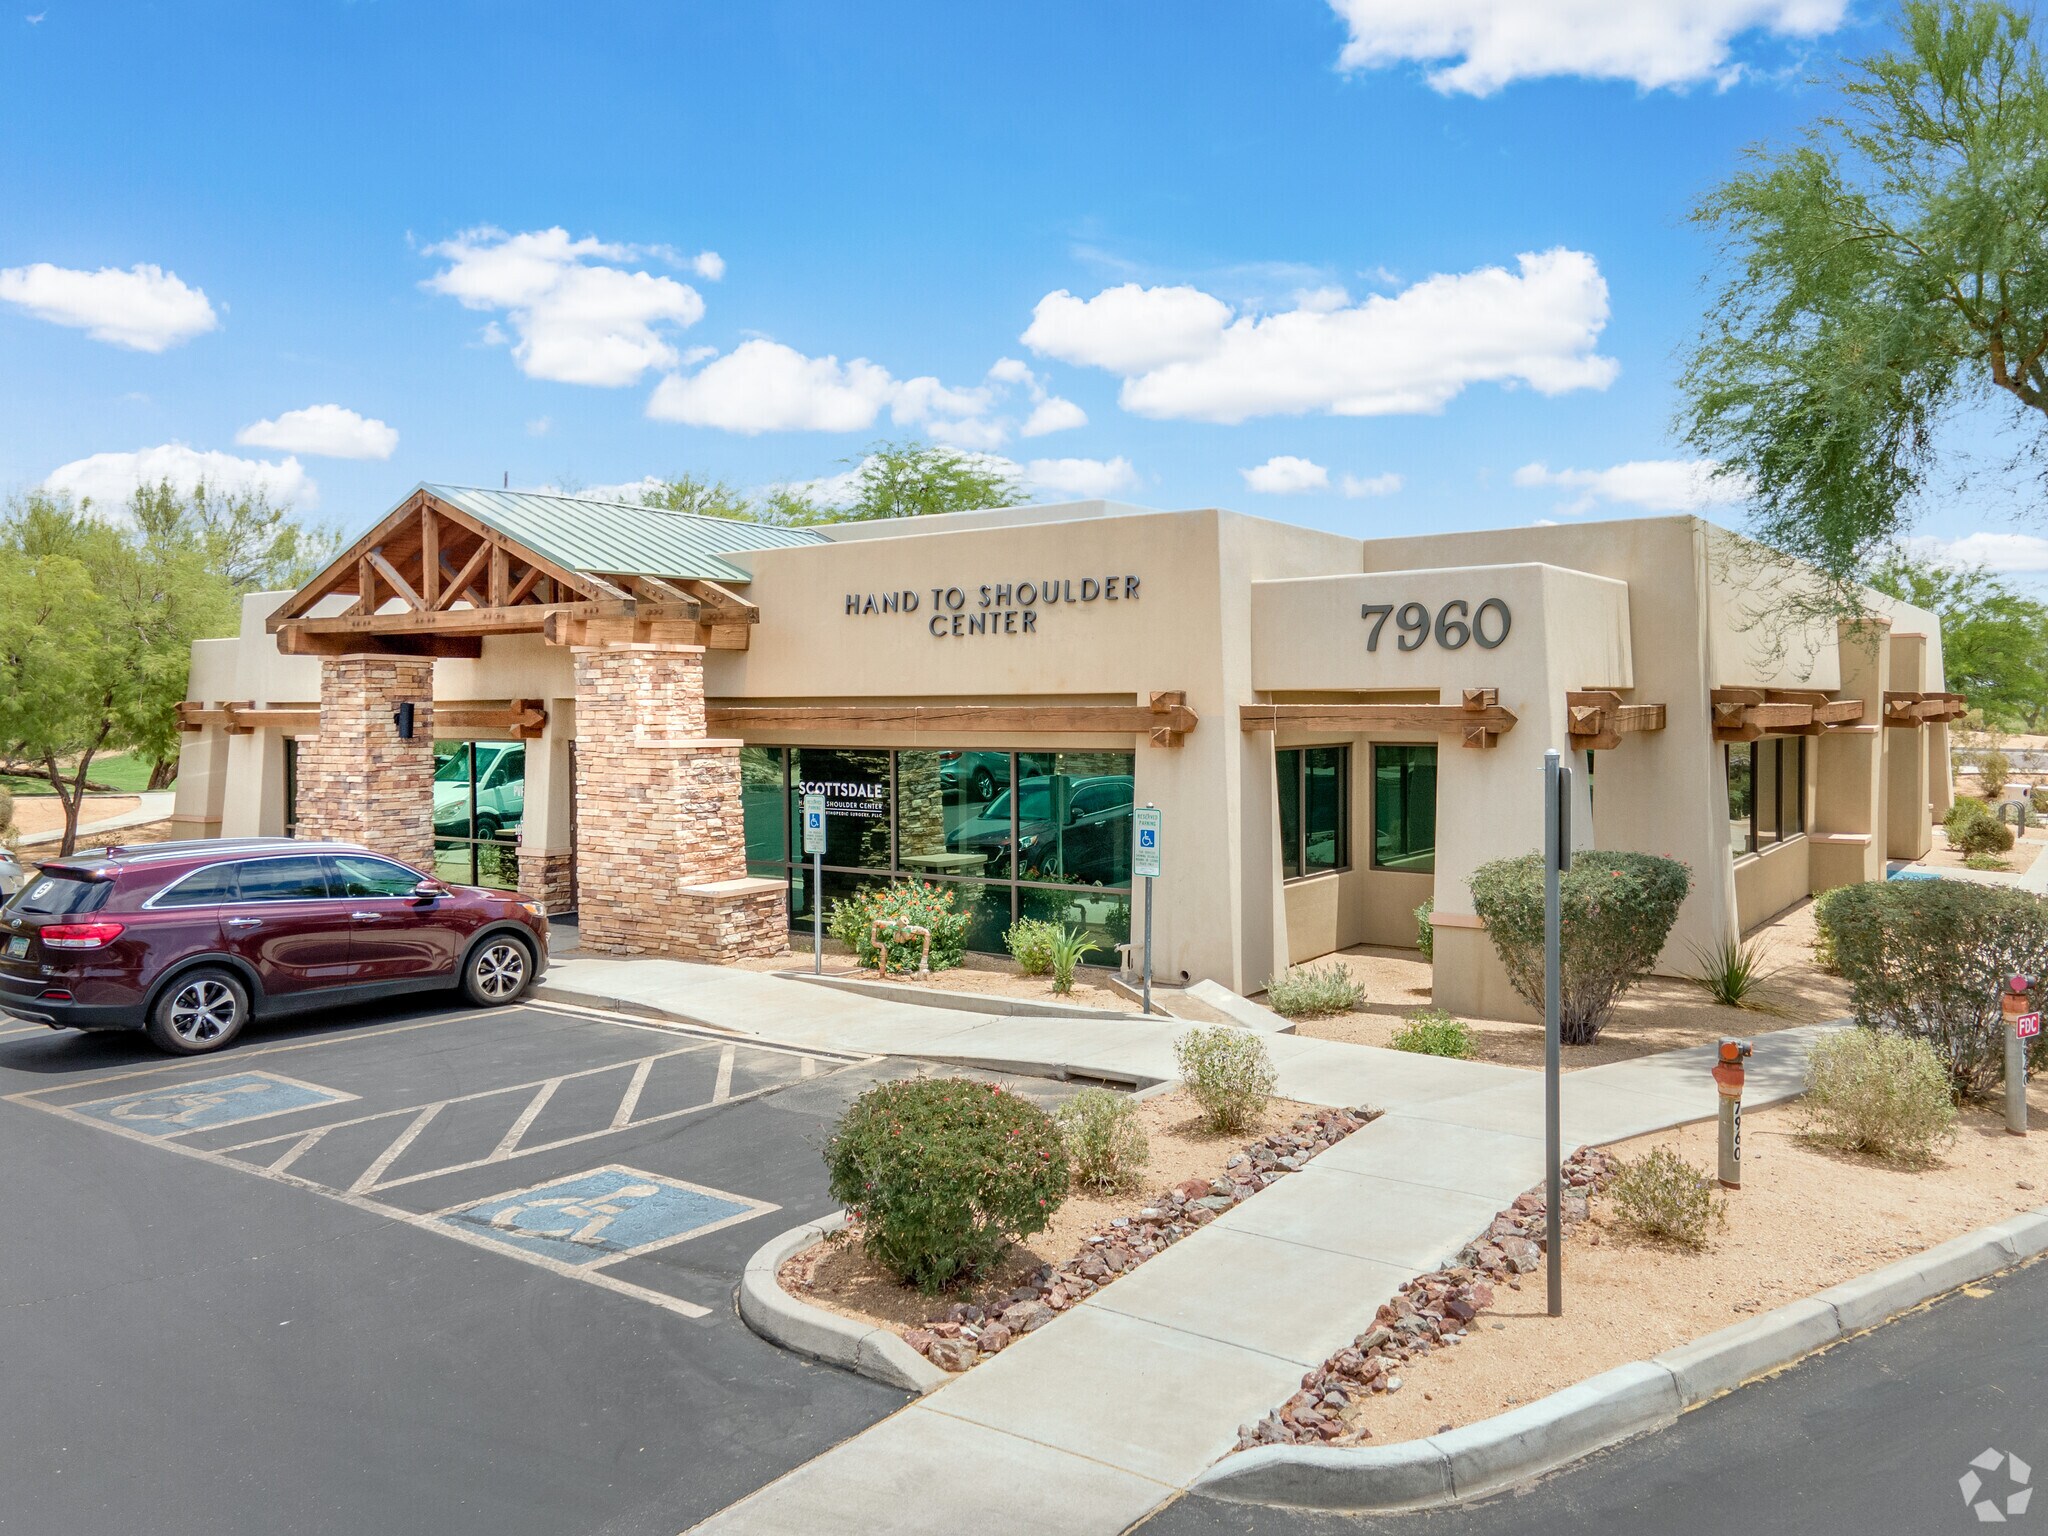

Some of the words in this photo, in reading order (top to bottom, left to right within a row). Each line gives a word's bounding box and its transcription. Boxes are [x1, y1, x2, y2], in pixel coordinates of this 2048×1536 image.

[845, 590, 920, 615] HAND
[931, 586, 966, 611] TO
[978, 574, 1140, 608] SHOULDER
[928, 609, 1037, 637] CENTER
[1361, 597, 1511, 652] 7960
[798, 781, 882, 798] SCOTTSDALE
[826, 801, 858, 809] SHOULDER
[859, 802, 882, 810] CENTER
[2019, 1015, 2037, 1035] FDC
